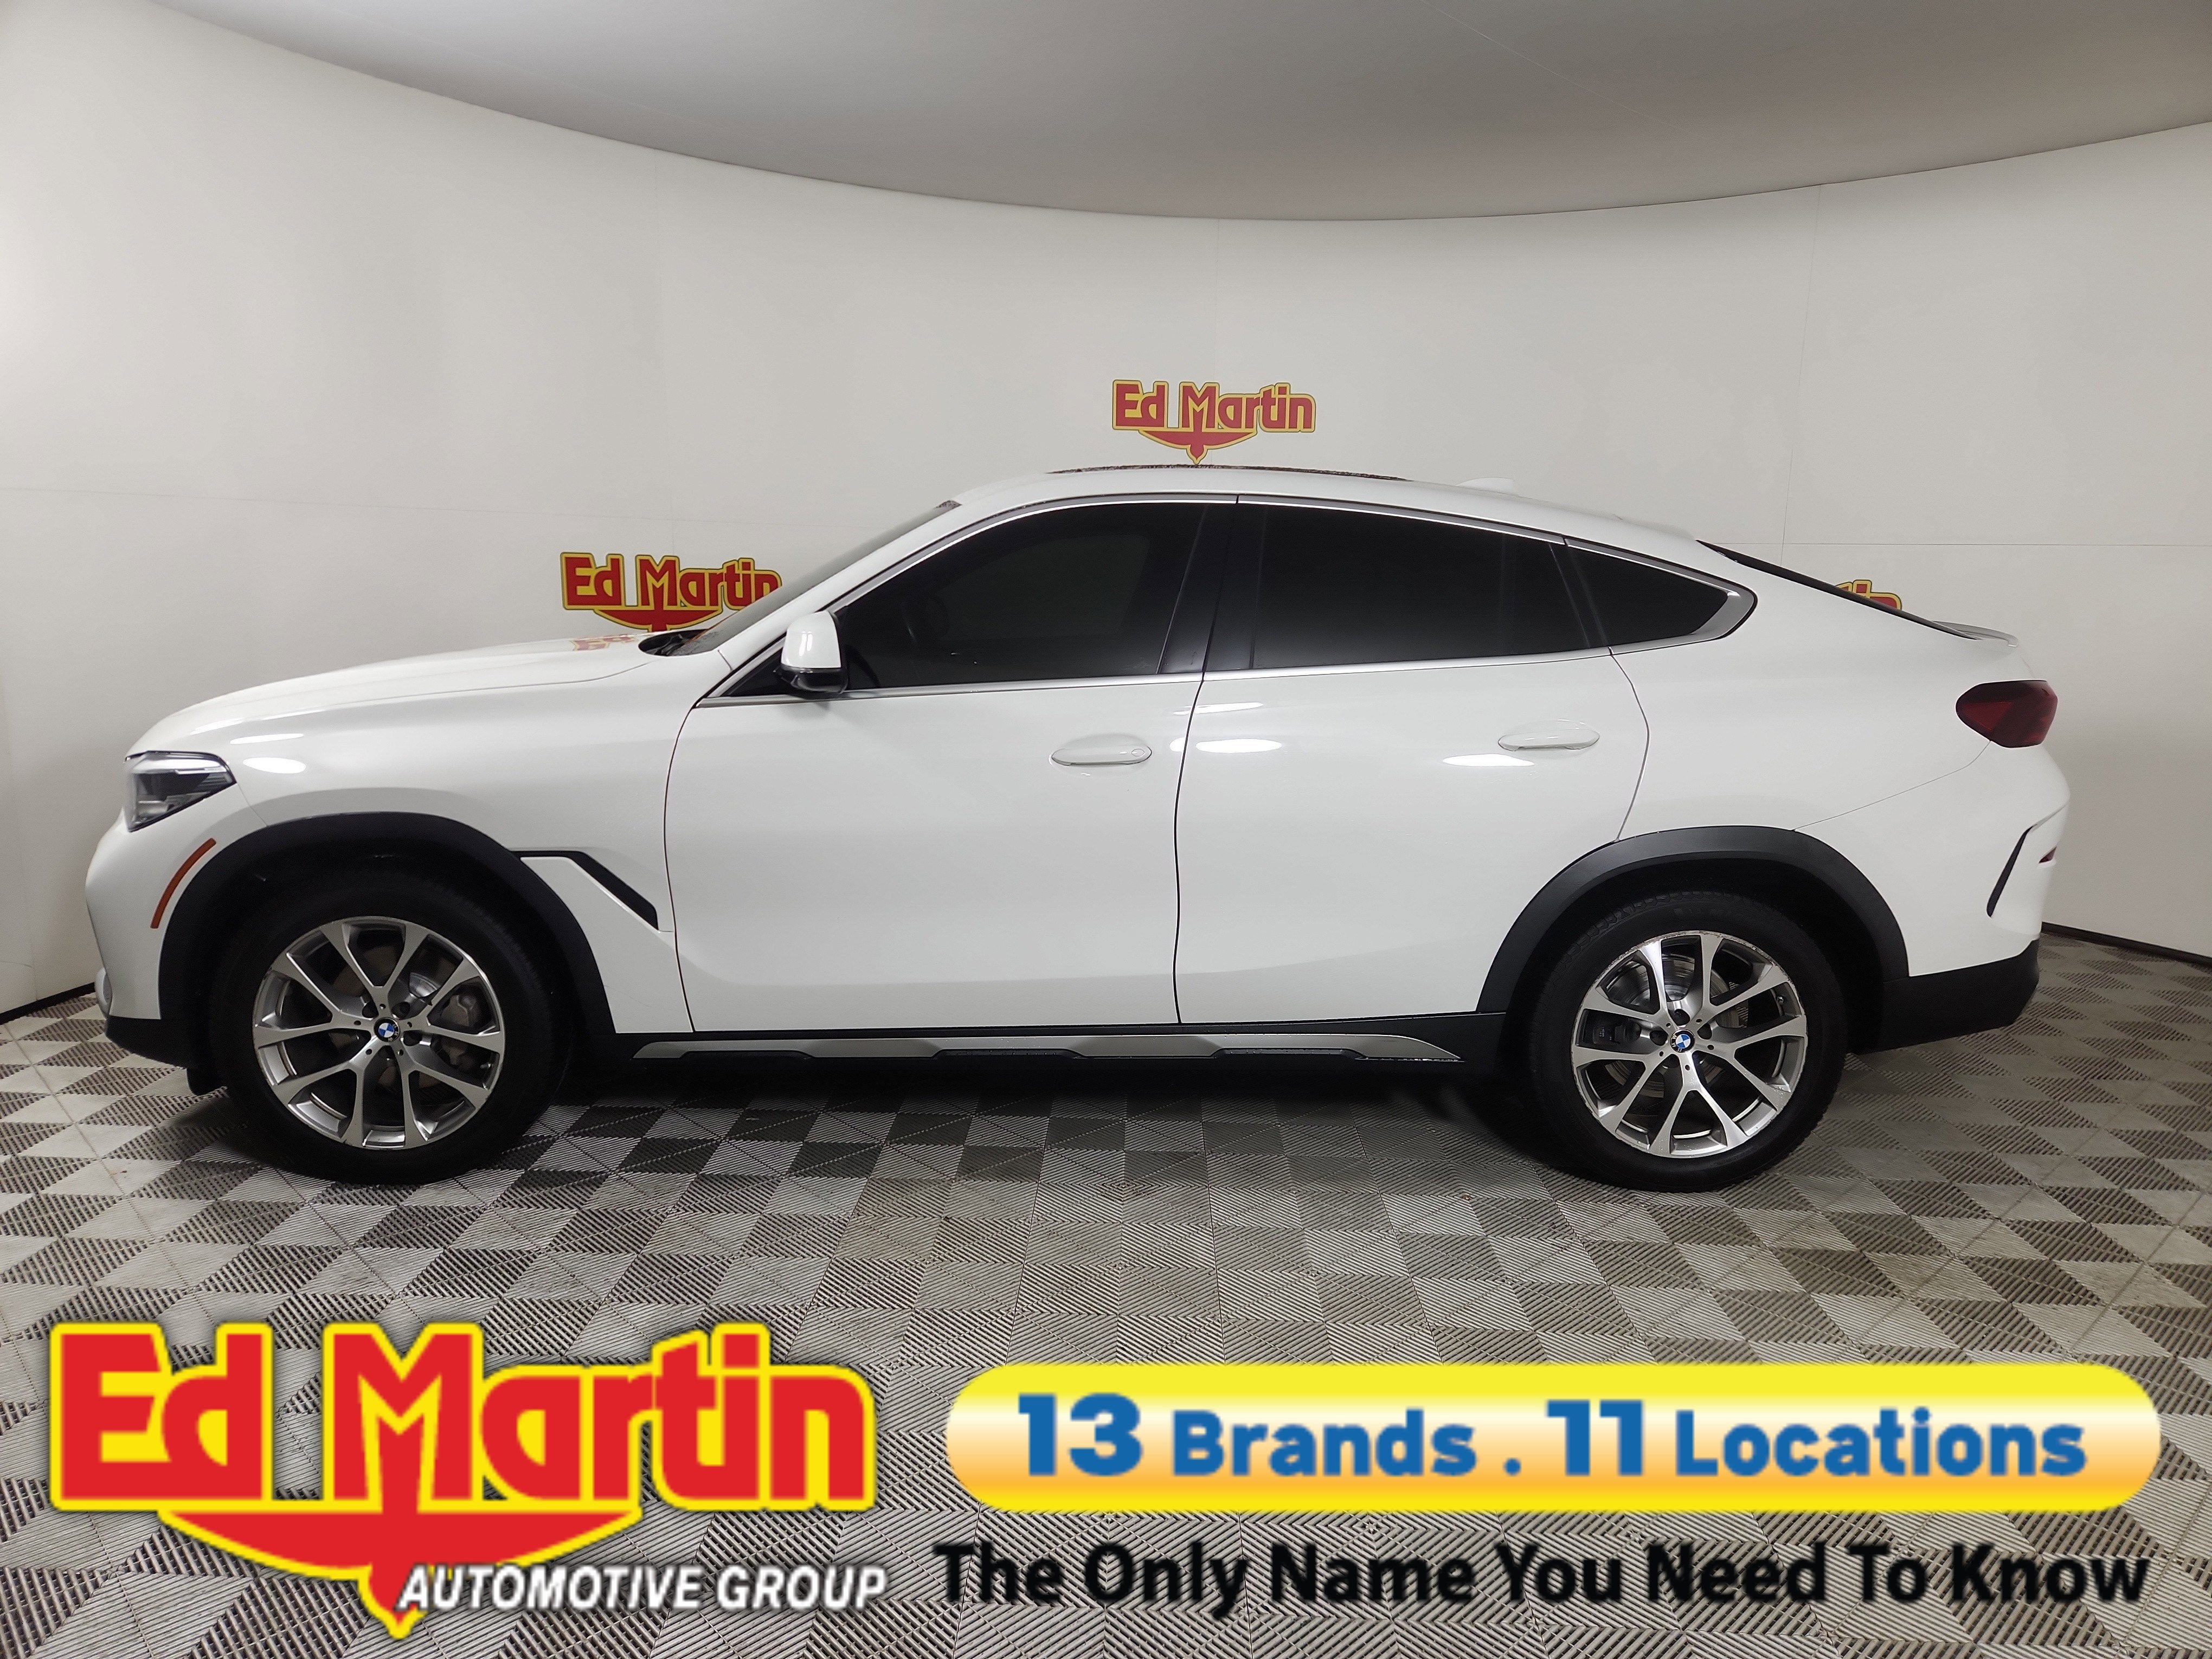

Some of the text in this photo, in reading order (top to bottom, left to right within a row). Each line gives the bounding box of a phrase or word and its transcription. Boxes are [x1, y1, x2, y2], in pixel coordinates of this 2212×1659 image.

[1114, 381, 1314, 431] Ed Martin
[562, 554, 623, 608] Ed
